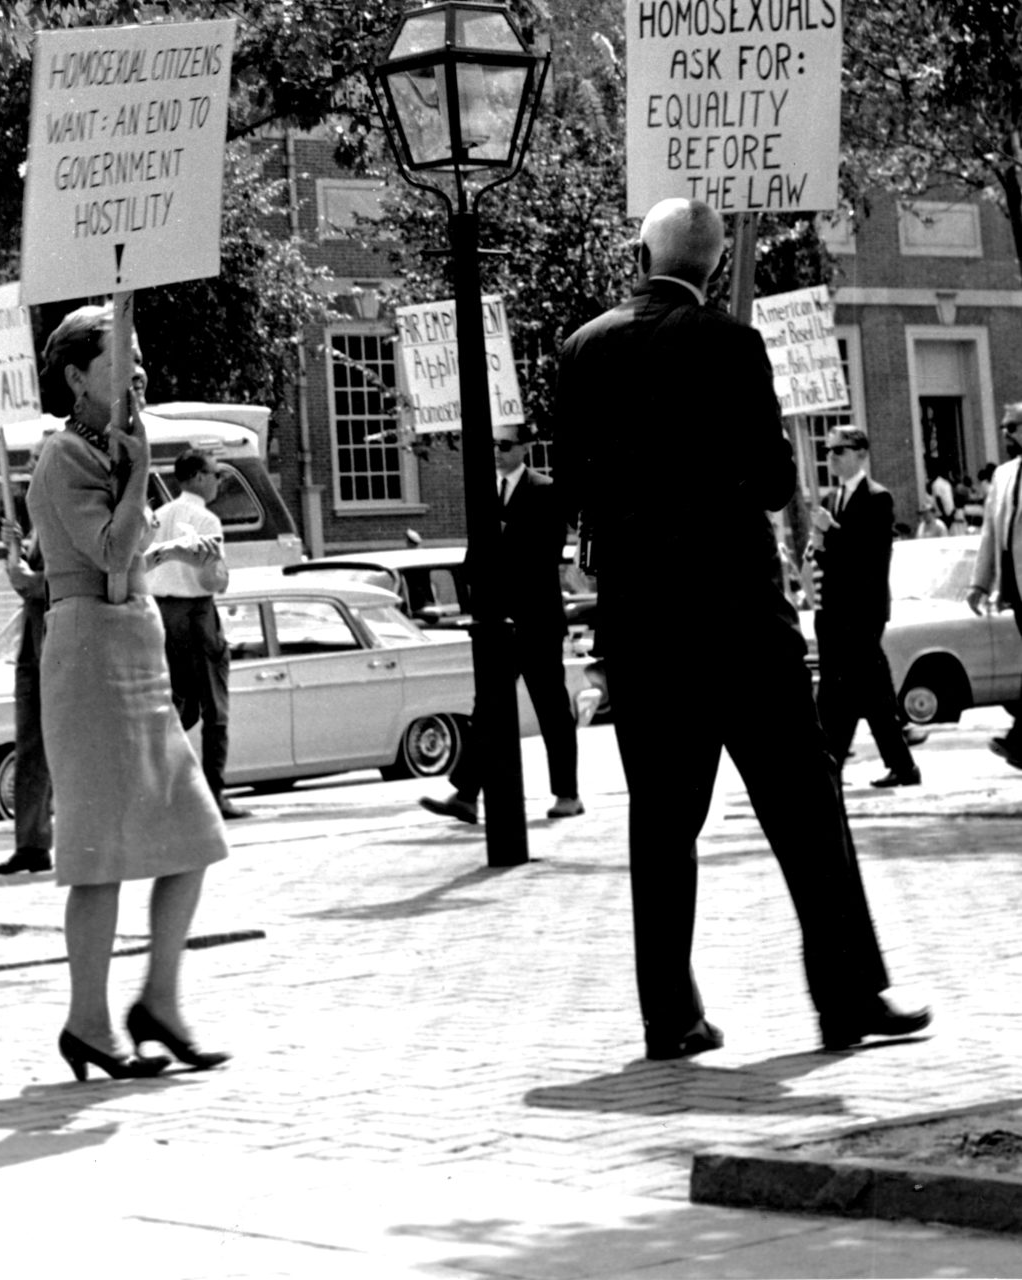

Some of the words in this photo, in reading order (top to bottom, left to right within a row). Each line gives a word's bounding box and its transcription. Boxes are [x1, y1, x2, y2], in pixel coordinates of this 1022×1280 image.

[49, 49, 147, 90] HOMOSEXUAL
[152, 43, 223, 81] CITIZENS
[670, 48, 722, 80] ASK
[739, 42, 805, 80] FOR:
[111, 103, 143, 137] AN
[145, 98, 181, 134] END
[188, 95, 210, 129] TO
[647, 88, 789, 130] EQUALITY
[55, 148, 185, 191] GOVERNMENT
[667, 133, 782, 170] BEFORE
[687, 176, 736, 210] THE
[747, 172, 808, 209] LAW
[74, 191, 174, 238] HOSTILITY
[413, 346, 457, 389] Appli
